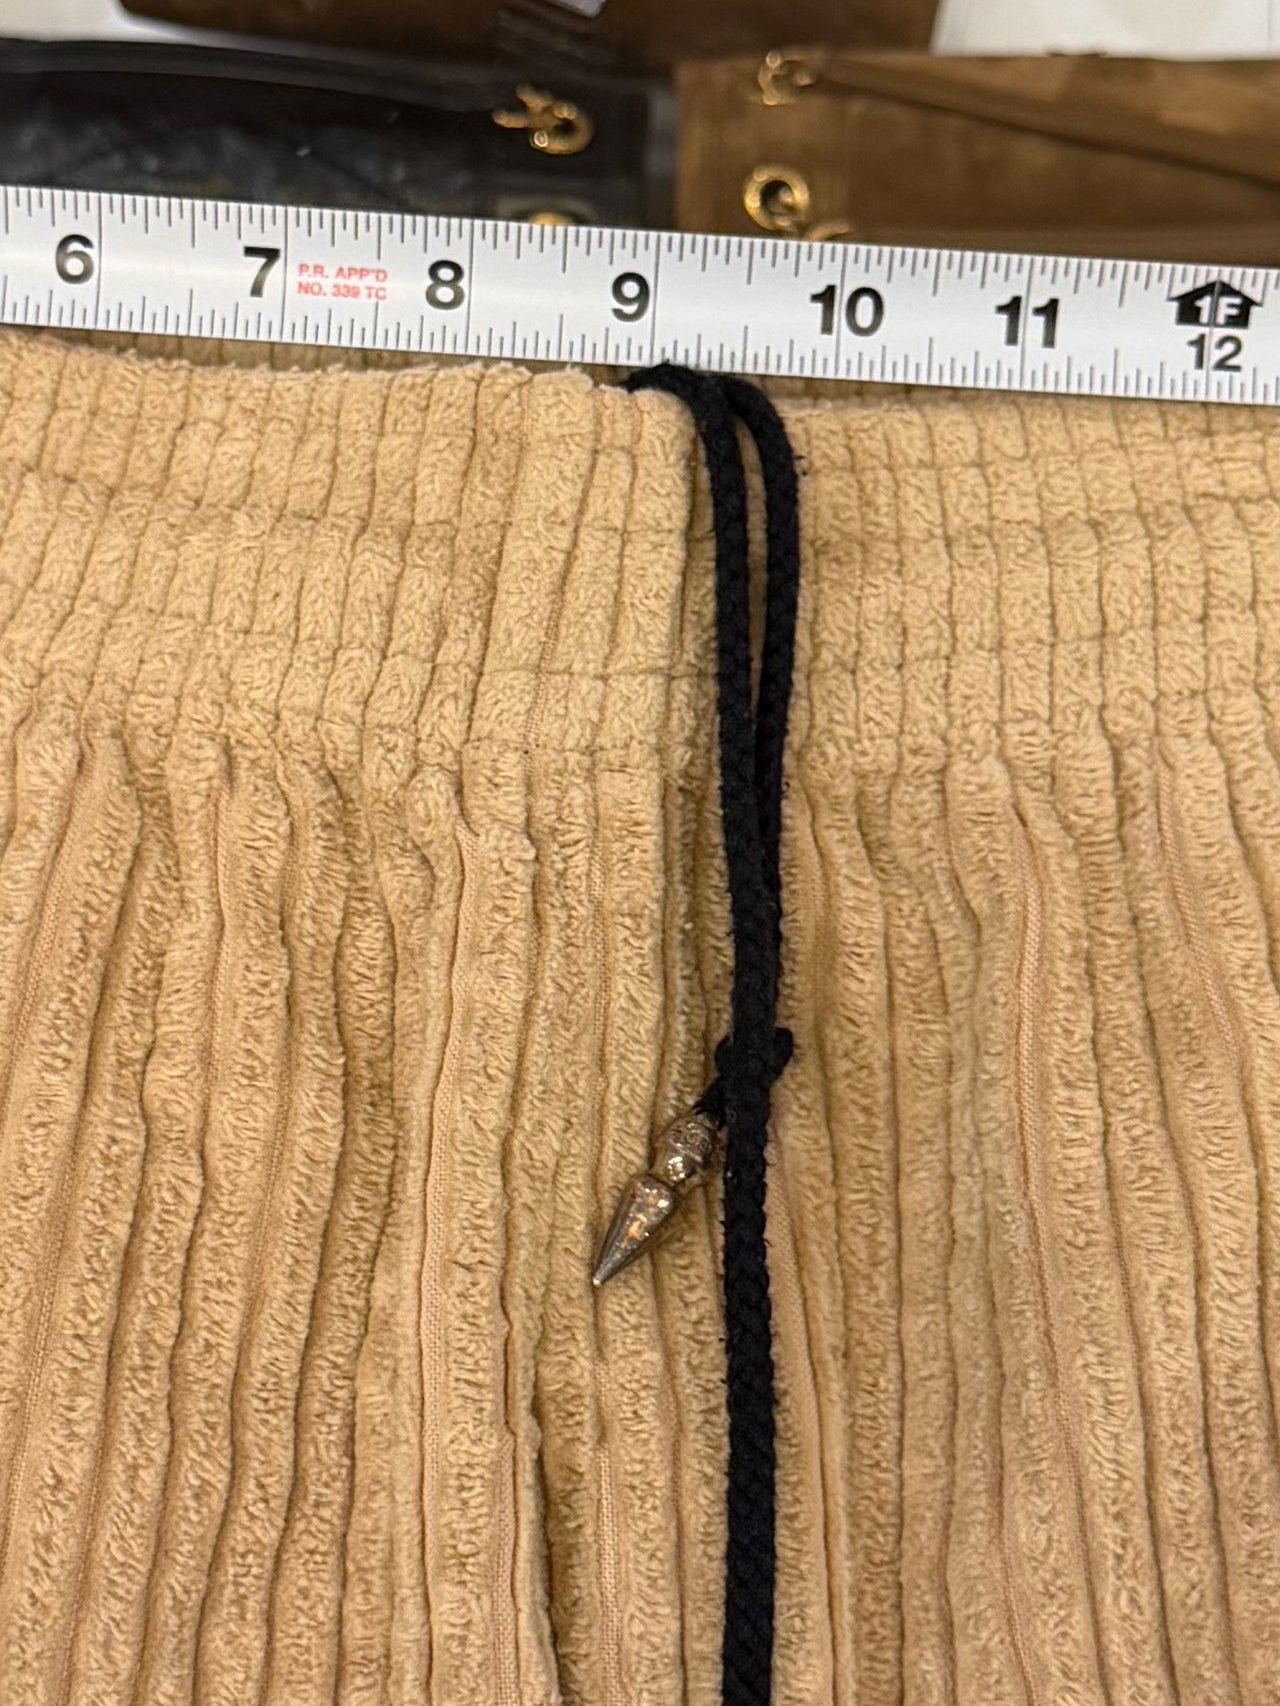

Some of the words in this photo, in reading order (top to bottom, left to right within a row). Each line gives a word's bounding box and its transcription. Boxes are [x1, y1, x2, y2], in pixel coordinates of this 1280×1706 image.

[55, 234, 95, 284] 6
[243, 246, 281, 298] 7
[297, 263, 329, 278] P.R.
[297, 281, 327, 297] NO.
[364, 286, 387, 301] TC
[425, 259, 465, 311] 8
[611, 272, 650, 322] 9
[810, 284, 884, 337] 10
[995, 295, 1060, 349] 11
[1194, 296, 1244, 325] 1F
[1187, 334, 1243, 372] 12
